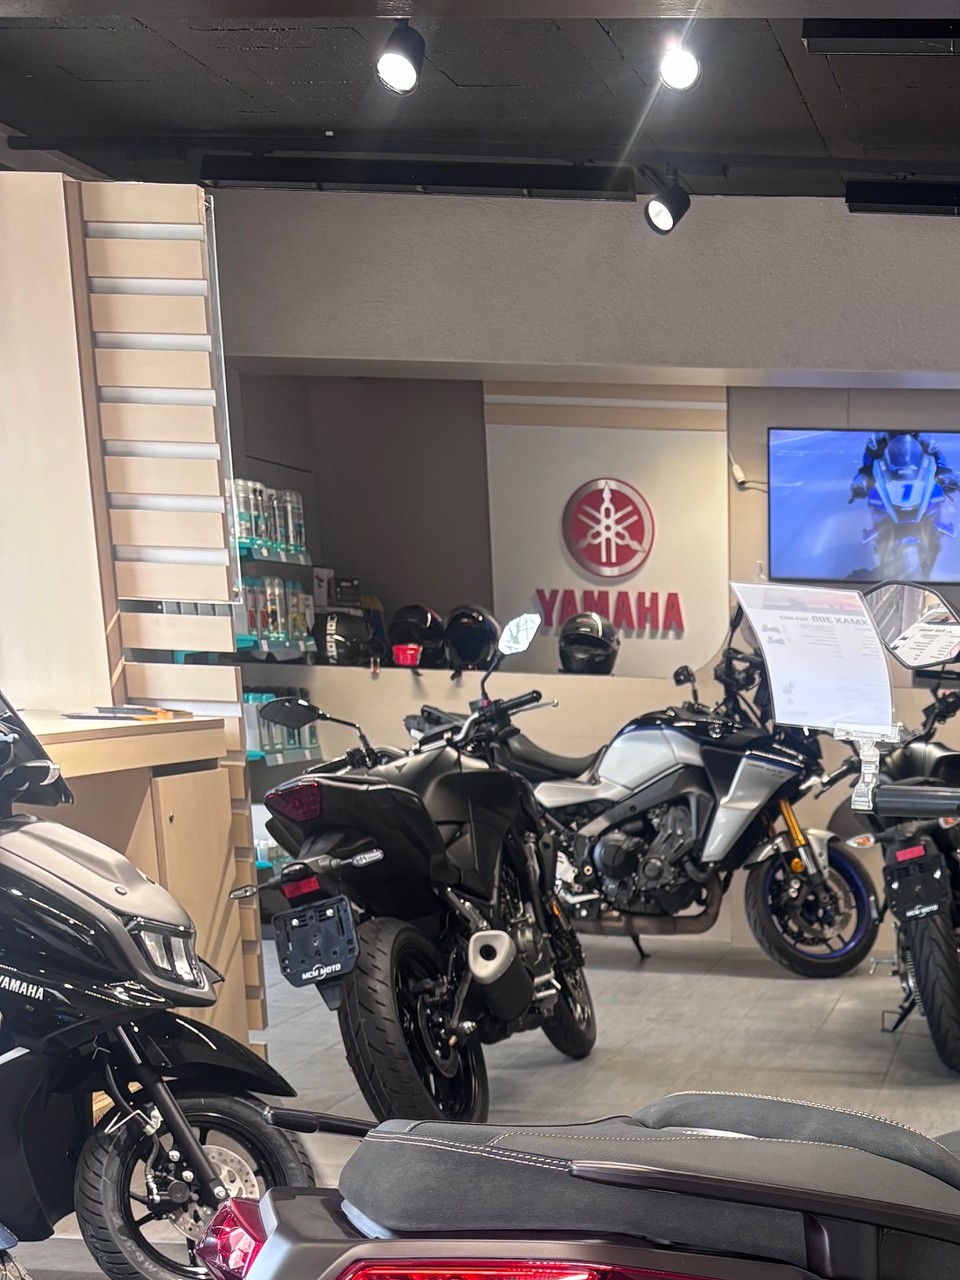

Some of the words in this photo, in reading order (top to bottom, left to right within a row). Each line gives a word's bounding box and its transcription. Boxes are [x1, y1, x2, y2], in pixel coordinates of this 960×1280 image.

[536, 589, 684, 631] YAMAHA
[301, 969, 318, 980] MCM
[320, 963, 341, 975] MOTO
